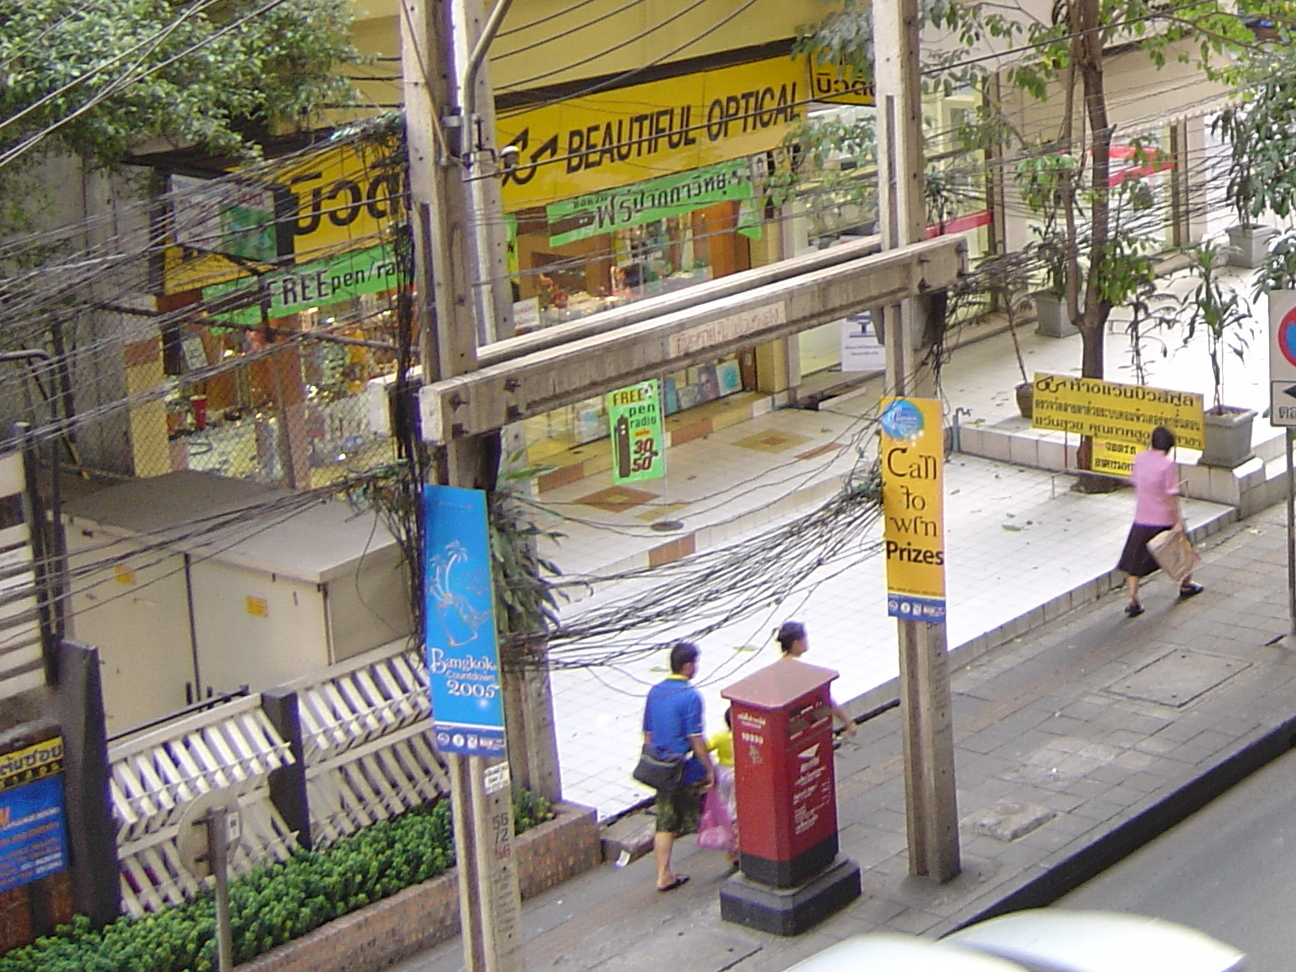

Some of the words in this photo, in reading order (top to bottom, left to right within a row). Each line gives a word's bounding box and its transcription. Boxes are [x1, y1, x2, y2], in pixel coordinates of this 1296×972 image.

[566, 104, 697, 175] BEAUTIFUL
[706, 80, 802, 142] OPTICAL
[613, 388, 645, 406] FREE
[629, 403, 656, 418] pen
[630, 415, 657, 429] radio
[887, 446, 938, 480] Call
[900, 484, 926, 511] to
[890, 516, 937, 538] win
[886, 540, 944, 567] Prizes
[431, 647, 497, 674] Bangkok
[446, 679, 500, 699] 2005
